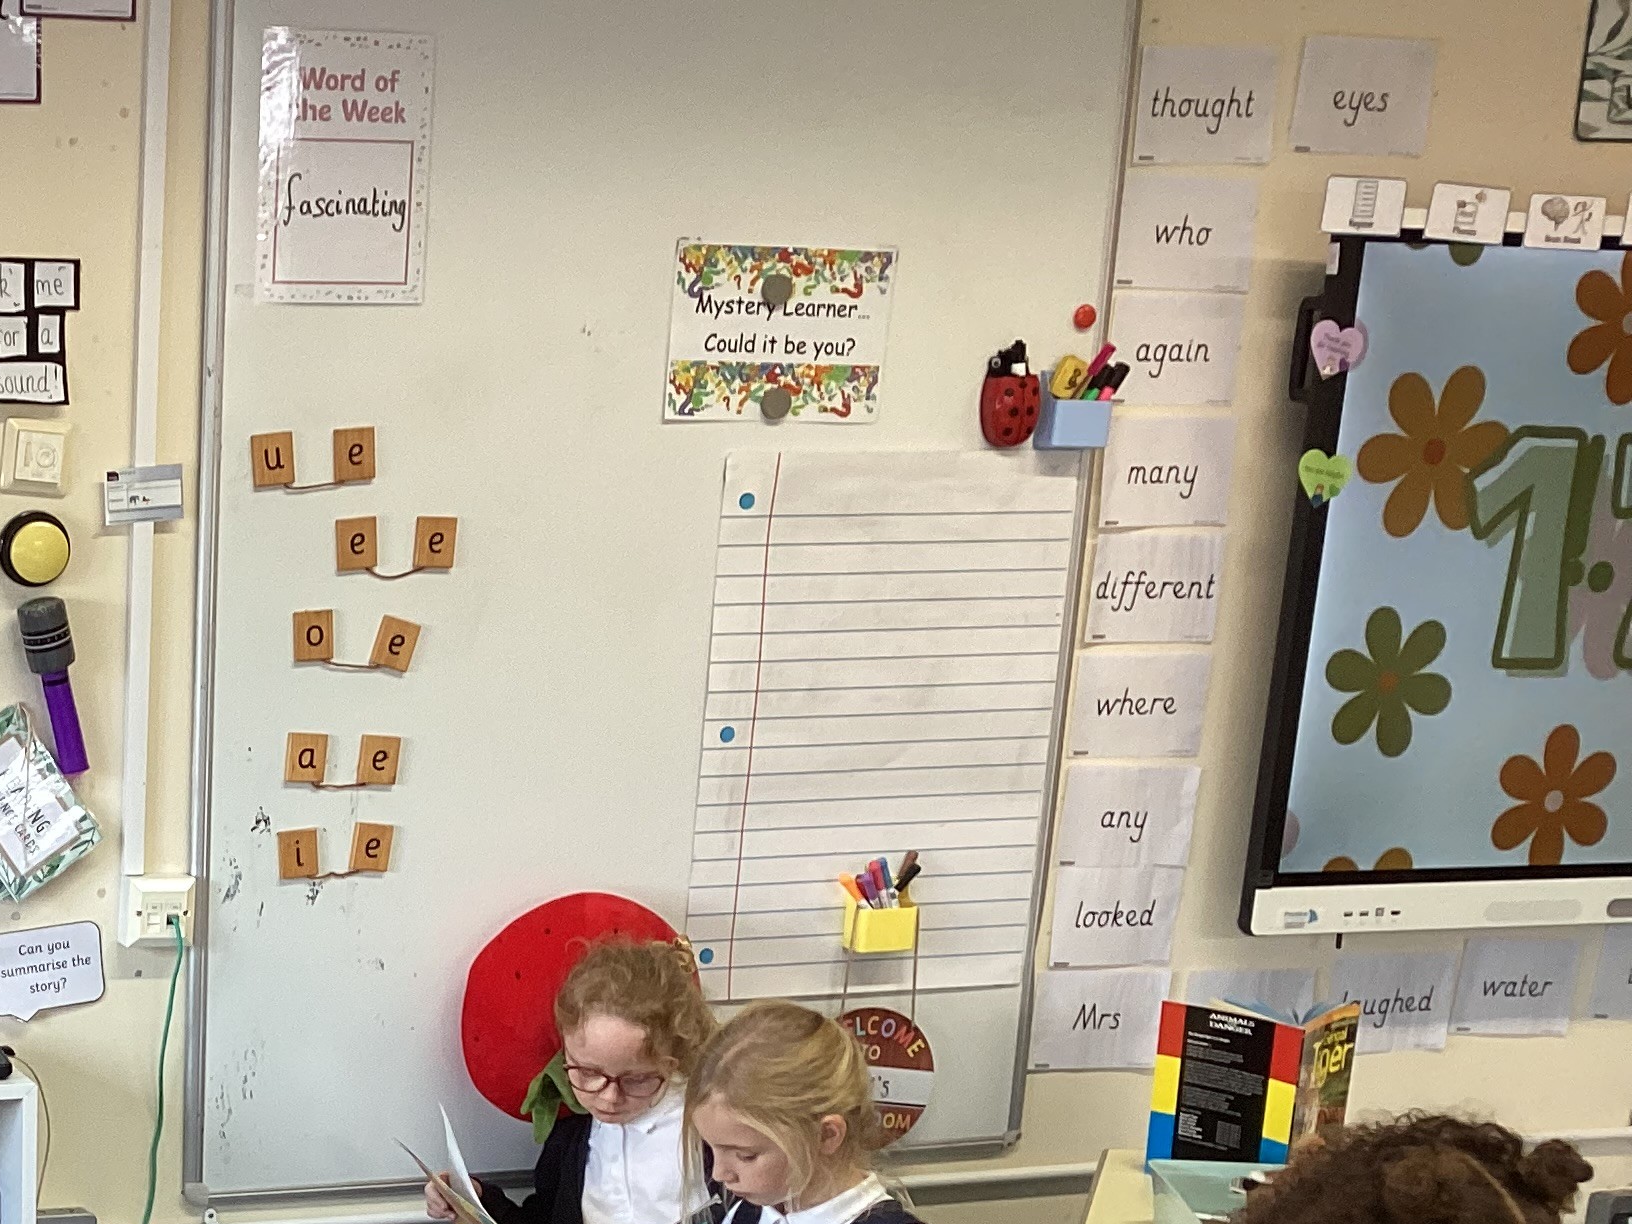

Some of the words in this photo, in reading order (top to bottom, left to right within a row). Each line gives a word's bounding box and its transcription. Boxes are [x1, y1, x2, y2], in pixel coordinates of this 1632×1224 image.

[300, 66, 366, 92] Word
[374, 69, 401, 92] of
[342, 99, 406, 124] Week
[1150, 86, 1255, 135] thought
[1333, 89, 1390, 127] eyes
[282, 172, 407, 233] fascinating
[1155, 213, 1212, 246] who
[36, 278, 65, 296] me
[695, 294, 776, 322] Mystery
[41, 328, 54, 346] a
[704, 332, 757, 354] Could
[763, 335, 778, 354] it
[784, 336, 807, 355] be
[813, 338, 856, 361] you?
[1135, 338, 1210, 379] again
[264, 446, 285, 471] u
[347, 442, 364, 465] e
[1128, 464, 1199, 500] many
[349, 532, 366, 555] e
[428, 531, 445, 554] e
[1096, 570, 1216, 612] different
[305, 624, 324, 647] o
[387, 632, 406, 656] e
[1096, 686, 1177, 716] where
[298, 747, 317, 770] a
[372, 749, 389, 771] e
[1100, 809, 1148, 843] any
[294, 839, 305, 868] i
[364, 837, 381, 859] e
[1074, 899, 1157, 929] looked
[18, 944, 43, 956] Can
[47, 940, 70, 955] you
[0, 959, 68, 979] summarise
[71, 954, 92, 968] the
[29, 977, 68, 995] story?
[1482, 974, 1553, 998] water
[1072, 1003, 1121, 1032] Mrs
[1209, 1013, 1256, 1028] ANIMALS
[1342, 985, 1435, 1029] ughed
[843, 1015, 927, 1059] LCOME
[1209, 1020, 1253, 1036] DANGER
